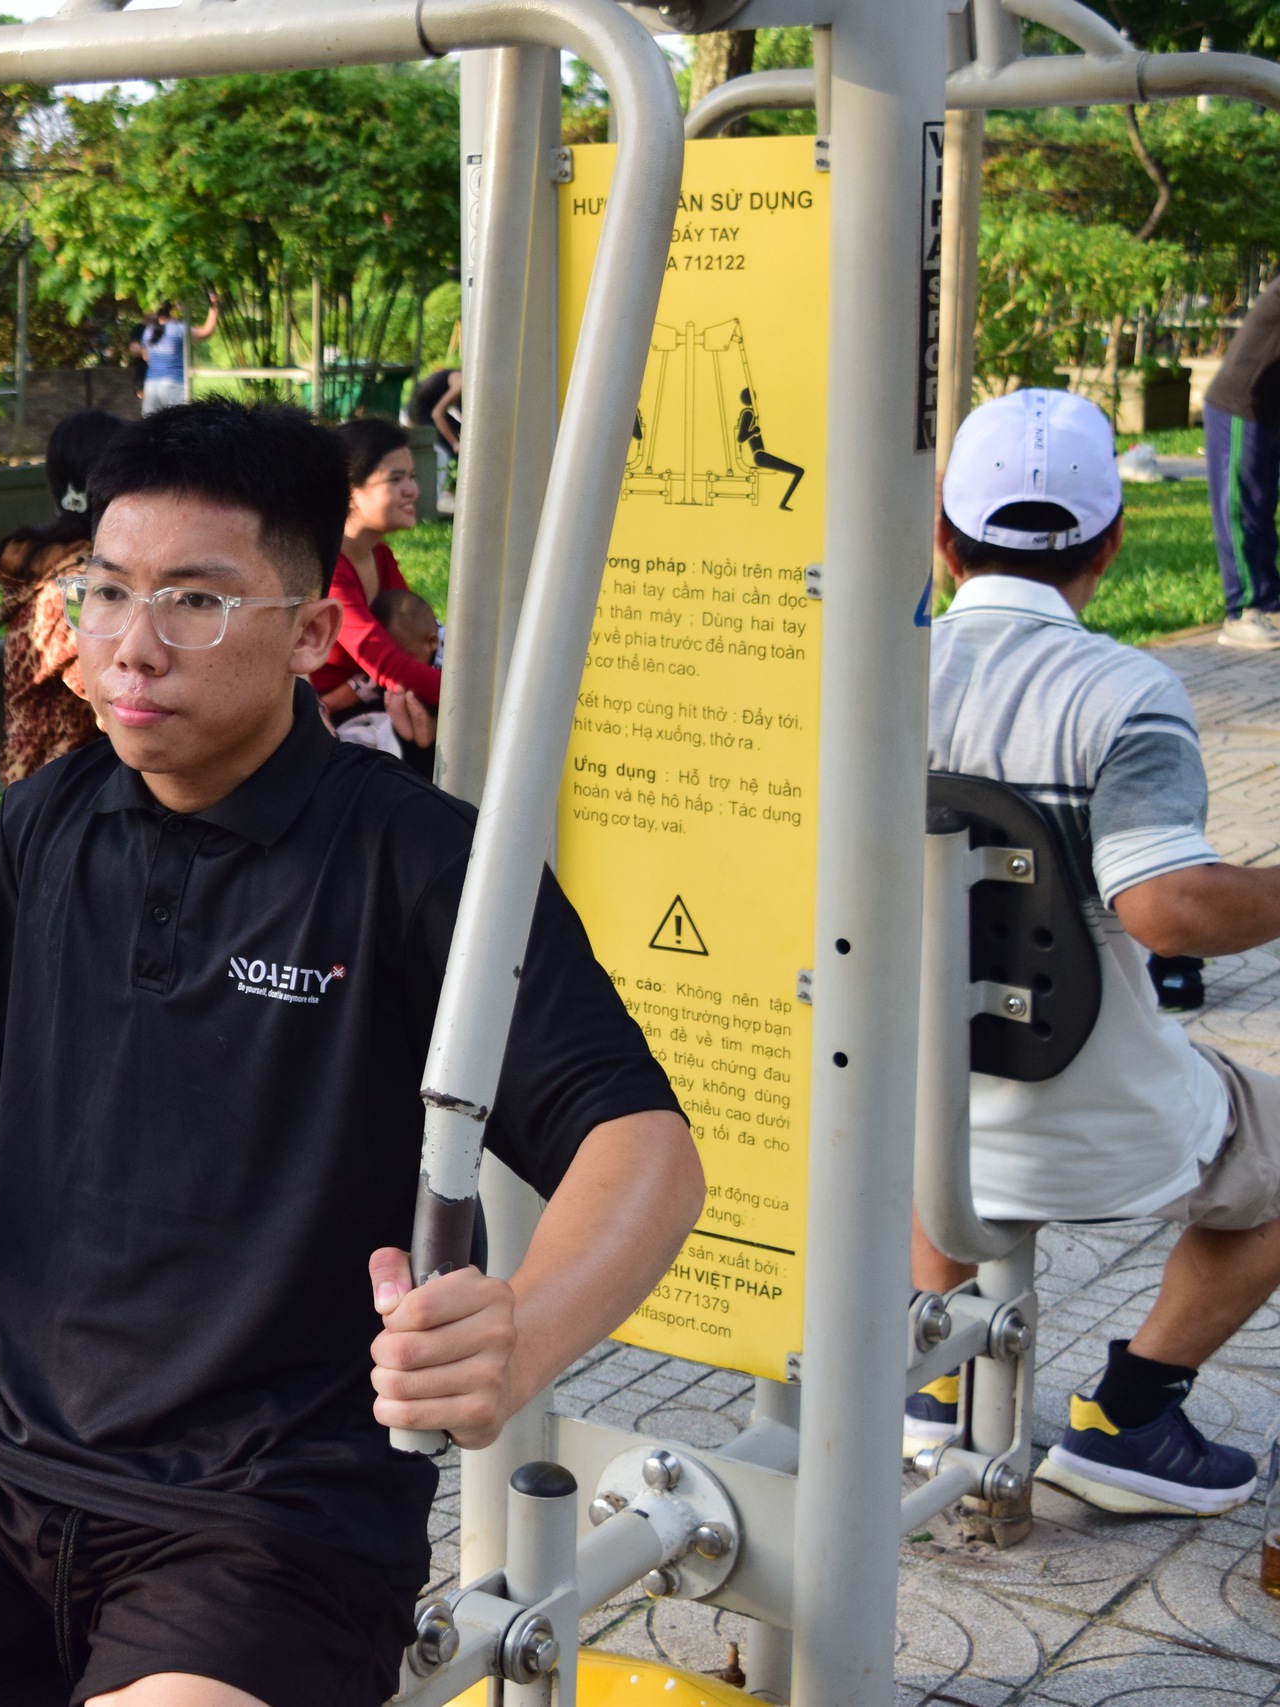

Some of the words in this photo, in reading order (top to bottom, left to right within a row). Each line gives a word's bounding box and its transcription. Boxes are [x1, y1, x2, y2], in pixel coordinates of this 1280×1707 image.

[711, 189, 742, 211] SỬ
[750, 191, 813, 215] DỤNG
[709, 228, 740, 242] TAY
[666, 256, 677, 271] A
[684, 255, 745, 270] 712122
[646, 559, 687, 575] pháp
[702, 560, 736, 579] Ngồi
[742, 563, 772, 579] trên
[614, 580, 636, 595] hai
[643, 583, 665, 601] tay
[672, 582, 704, 600] cầm
[712, 587, 735, 603] hai
[742, 587, 770, 605] cần
[778, 593, 808, 610] dọc
[610, 605, 642, 621] thân
[650, 609, 682, 628] máy
[702, 612, 742, 633] Dùng
[751, 616, 774, 632] hai
[783, 619, 806, 638] tay
[604, 627, 621, 644] về
[625, 632, 656, 648] phía
[661, 635, 702, 651] trước
[706, 635, 724, 653] để
[729, 642, 766, 661] nâng
[771, 644, 805, 660] toàn
[595, 656, 613, 668] cơ
[618, 653, 639, 671] thể
[643, 658, 664, 673] lên
[668, 663, 700, 677] cao.
[603, 695, 632, 713] hợp
[637, 700, 673, 719] cùng
[679, 702, 697, 719] hít
[702, 706, 728, 722] thở
[742, 707, 773, 730] Đẩy
[778, 714, 803, 731] tới,
[574, 717, 592, 731] hít
[595, 721, 621, 735] vào
[632, 723, 653, 739] Hạ
[656, 724, 706, 747] xuống,
[710, 732, 735, 748] thở
[738, 737, 753, 750] ra
[574, 755, 607, 778] Ứng
[616, 762, 656, 784] dụng
[679, 769, 700, 786] Hỗ
[709, 774, 730, 790] trợ
[740, 777, 758, 793] hệ
[768, 779, 802, 798] tuần
[573, 782, 609, 799] hoàn
[615, 788, 632, 802] và
[638, 790, 655, 806] hệ
[685, 794, 713, 815] hấp
[728, 800, 757, 818] Tác
[762, 806, 802, 827] dụng
[573, 807, 608, 827] vùng
[611, 813, 630, 825] cơ
[633, 814, 658, 833] tay,
[661, 820, 687, 834] vai.
[636, 978, 666, 993] cáo:
[676, 982, 722, 1004] Không
[732, 993, 759, 1008] nên
[770, 998, 792, 1015] tập
[625, 998, 640, 1014] ày
[644, 1002, 678, 1021] trong
[682, 1007, 730, 1029] trường
[733, 1015, 761, 1033] hợp
[765, 1021, 791, 1037] bạn
[670, 1027, 687, 1042] đề
[696, 1031, 712, 1047] về
[722, 1037, 742, 1051] tim
[752, 1044, 791, 1060] mạch
[674, 1052, 704, 1068] triệu
[711, 1059, 756, 1080] chứng
[764, 1067, 791, 1083] đau
[703, 1079, 745, 1101] không
[754, 1089, 790, 1109] dùng
[684, 1099, 720, 1116] chiều
[725, 1108, 751, 1122] cao
[756, 1112, 790, 1129] dưới
[713, 1124, 729, 1140] tối
[738, 1132, 755, 1146] đa
[764, 1137, 790, 1152] cho
[725, 1187, 760, 1208] động
[706, 1206, 745, 1227] dụng.
[688, 1245, 713, 1261] sản
[719, 1252, 749, 1269] xuất
[755, 1260, 778, 1276] bởi
[694, 1269, 731, 1290] VIỆT
[735, 1279, 783, 1300] PHÁP
[675, 1288, 730, 1313] 771379
